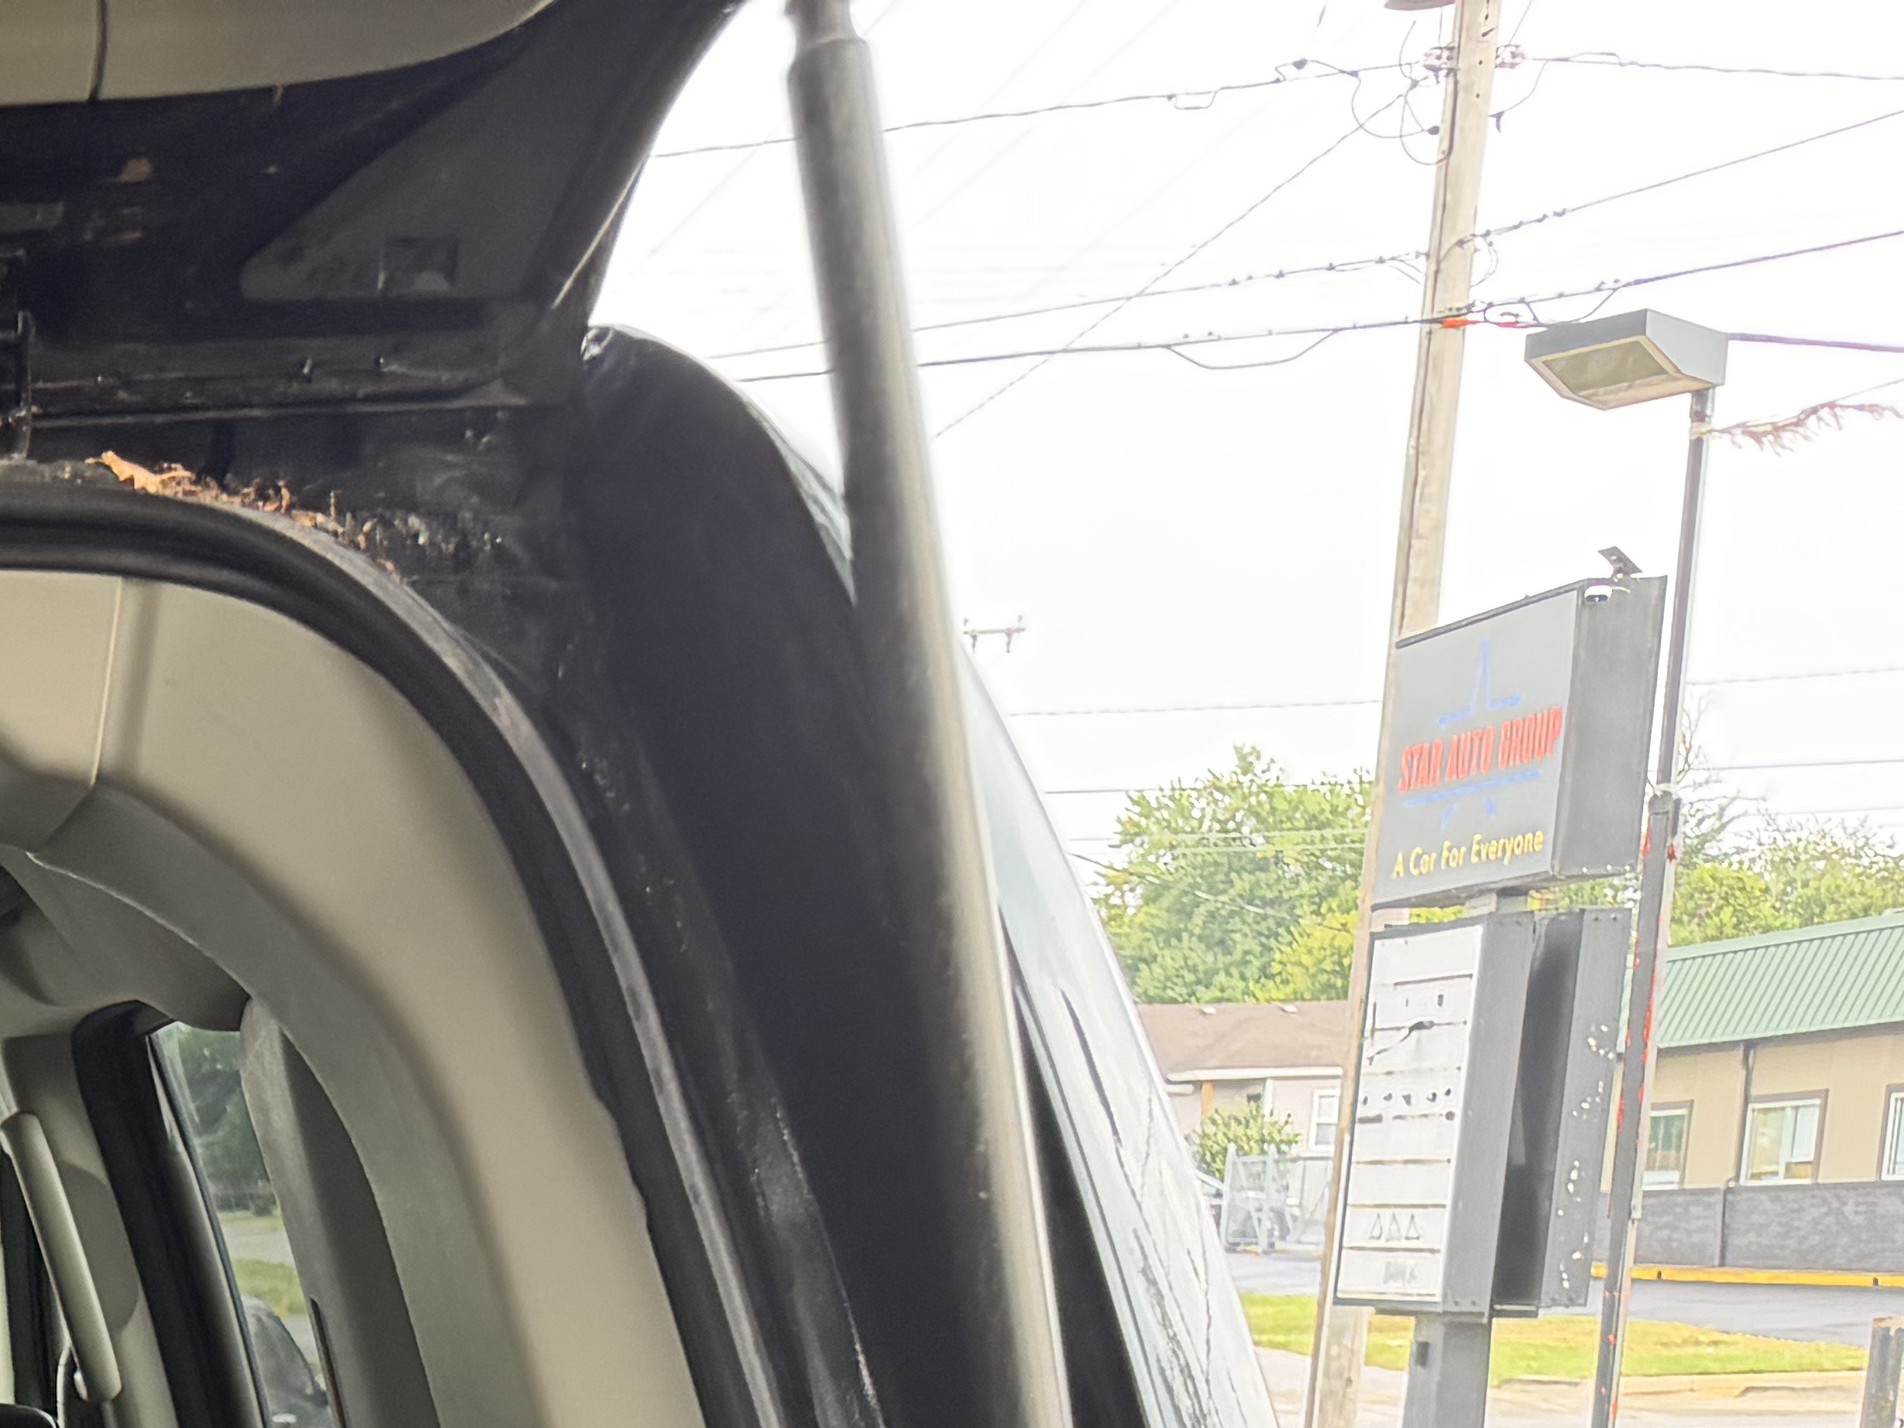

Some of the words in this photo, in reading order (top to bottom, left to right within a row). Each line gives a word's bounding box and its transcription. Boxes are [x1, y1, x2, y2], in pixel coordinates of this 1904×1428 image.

[1399, 739, 1444, 794] STAR
[1445, 725, 1495, 781] AUTO
[1497, 706, 1563, 770] GROUP
[1393, 852, 1405, 878] A
[1409, 846, 1437, 876] Car
[1441, 840, 1466, 870] For
[1470, 830, 1545, 865] Everyone
